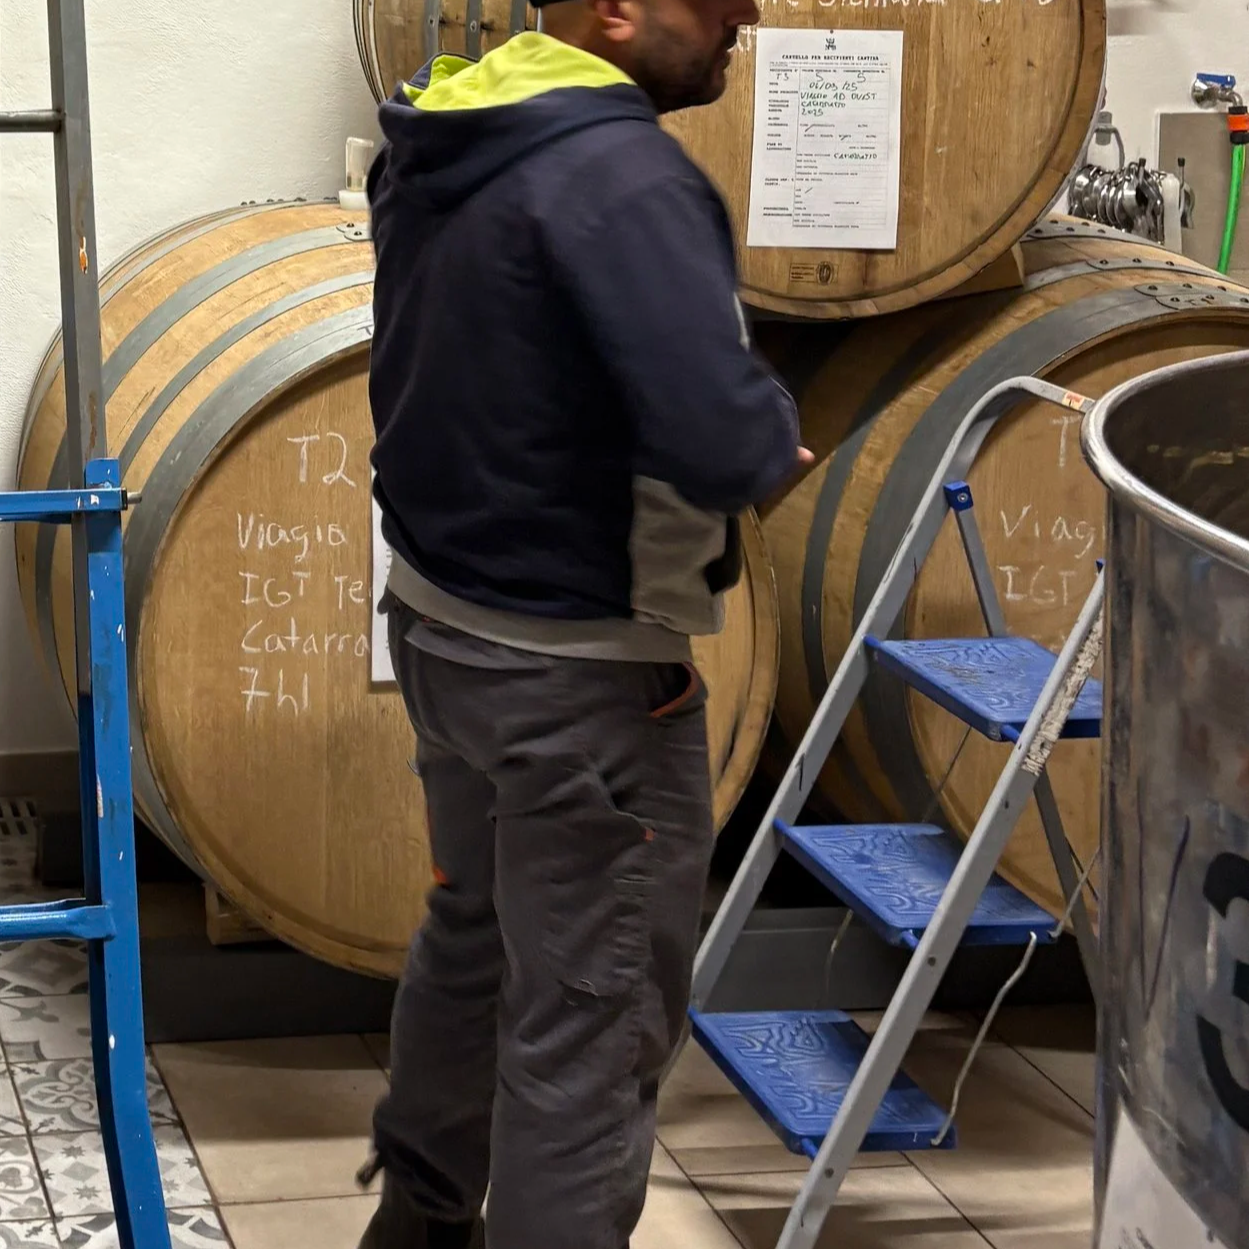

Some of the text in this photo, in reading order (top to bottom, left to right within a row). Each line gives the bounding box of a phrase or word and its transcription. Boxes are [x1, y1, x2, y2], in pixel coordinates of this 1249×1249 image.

[286, 431, 357, 487] T2
[238, 571, 311, 608] IGT
[998, 565, 1078, 606] IGT
